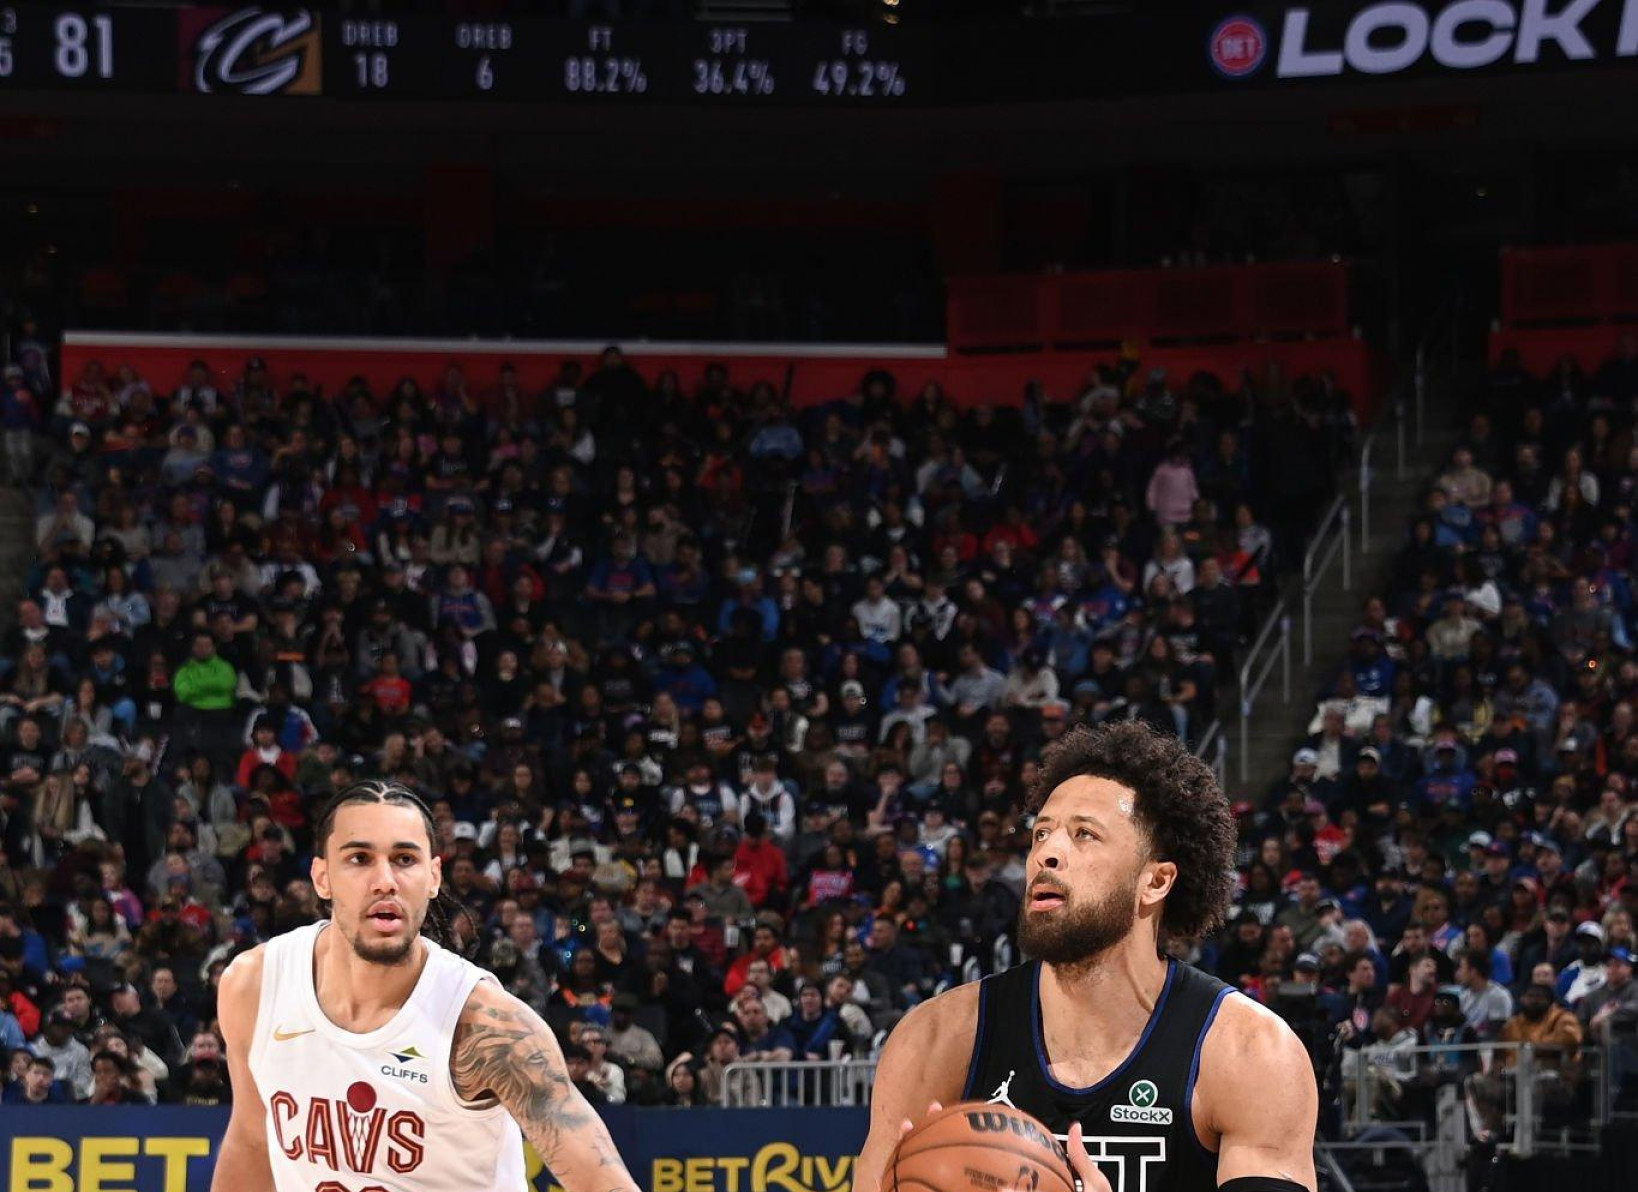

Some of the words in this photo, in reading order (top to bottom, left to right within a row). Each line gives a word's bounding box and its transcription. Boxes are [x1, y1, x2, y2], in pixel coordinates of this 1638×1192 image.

[54, 12, 113, 78] 81
[342, 20, 398, 47] DREB
[456, 23, 512, 49] OREB
[589, 26, 612, 50] FT
[710, 28, 747, 53] 3PT
[842, 30, 867, 55] FG
[1276, 0, 1598, 78] LOCK
[354, 53, 388, 88] 18
[476, 56, 494, 90] 6
[565, 56, 647, 92] 88.2%
[694, 59, 775, 95] 36.4%
[813, 61, 906, 96] 49.2%
[380, 1065, 428, 1084] CLIFFS
[270, 1081, 426, 1174] CAVS
[1112, 1106, 1170, 1123] StockX
